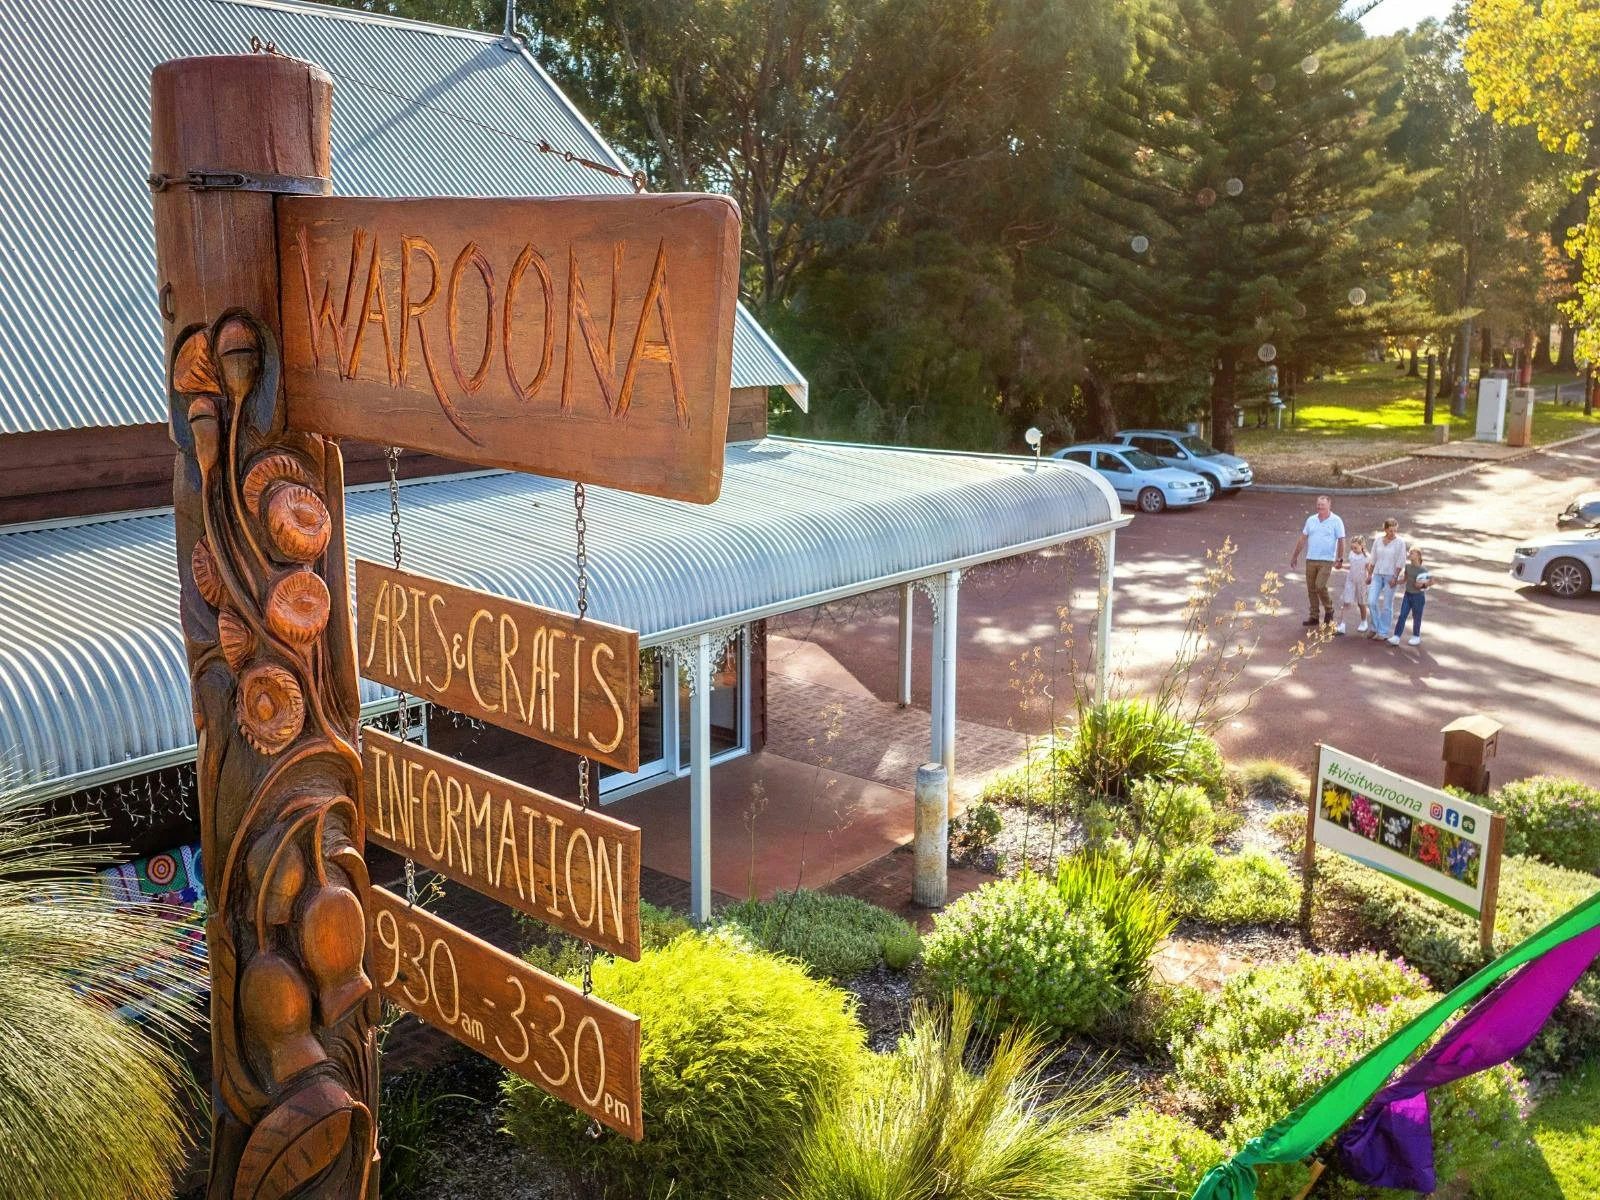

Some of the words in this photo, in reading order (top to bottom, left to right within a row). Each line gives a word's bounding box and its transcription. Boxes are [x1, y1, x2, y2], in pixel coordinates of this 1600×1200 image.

[298, 225, 691, 447] WAROONA
[365, 579, 451, 693] ARTS
[467, 608, 625, 753] CRAFTS
[368, 746, 625, 945] INFORMATION
[1327, 761, 1423, 813] #visitwaroona
